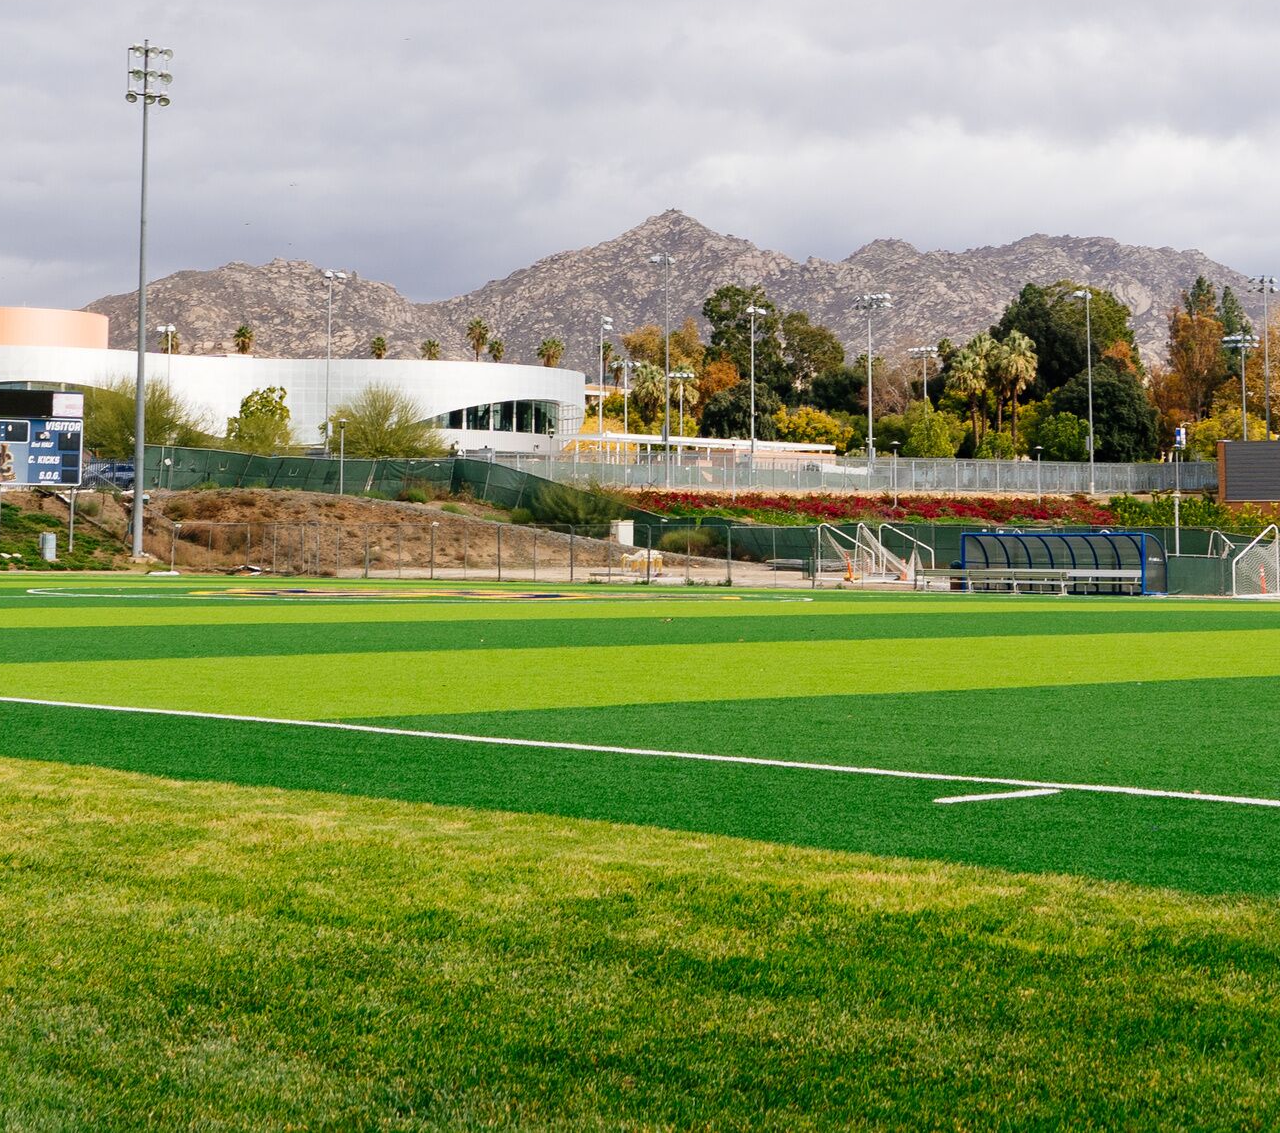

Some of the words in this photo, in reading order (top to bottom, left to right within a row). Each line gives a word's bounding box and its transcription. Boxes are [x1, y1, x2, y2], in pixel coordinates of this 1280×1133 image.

[46, 421, 80, 431] VISITOR
[38, 456, 60, 464] KICKS
[39, 471, 60, 479] S.O.G.
